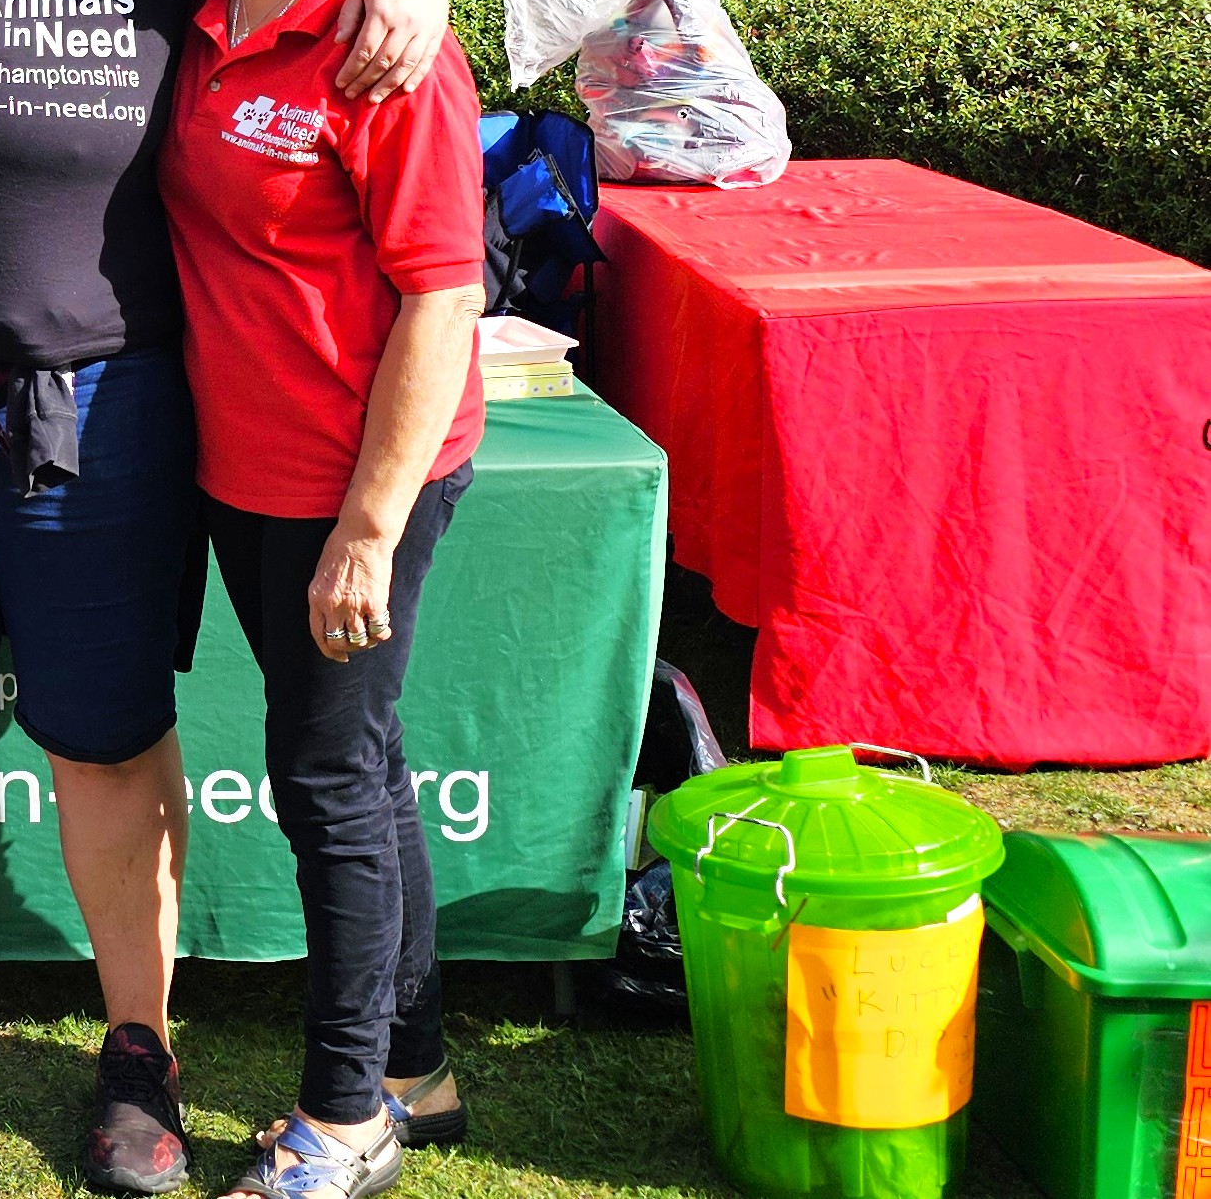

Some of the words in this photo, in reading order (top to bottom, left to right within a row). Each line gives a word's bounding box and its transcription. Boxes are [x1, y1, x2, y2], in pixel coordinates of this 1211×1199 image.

[4, 22, 31, 47] in
[35, 19, 137, 58] Need
[276, 103, 325, 128] Animals
[278, 121, 287, 131] in
[283, 121, 320, 143] Need
[221, 130, 320, 164] www.animals-in-need.org
